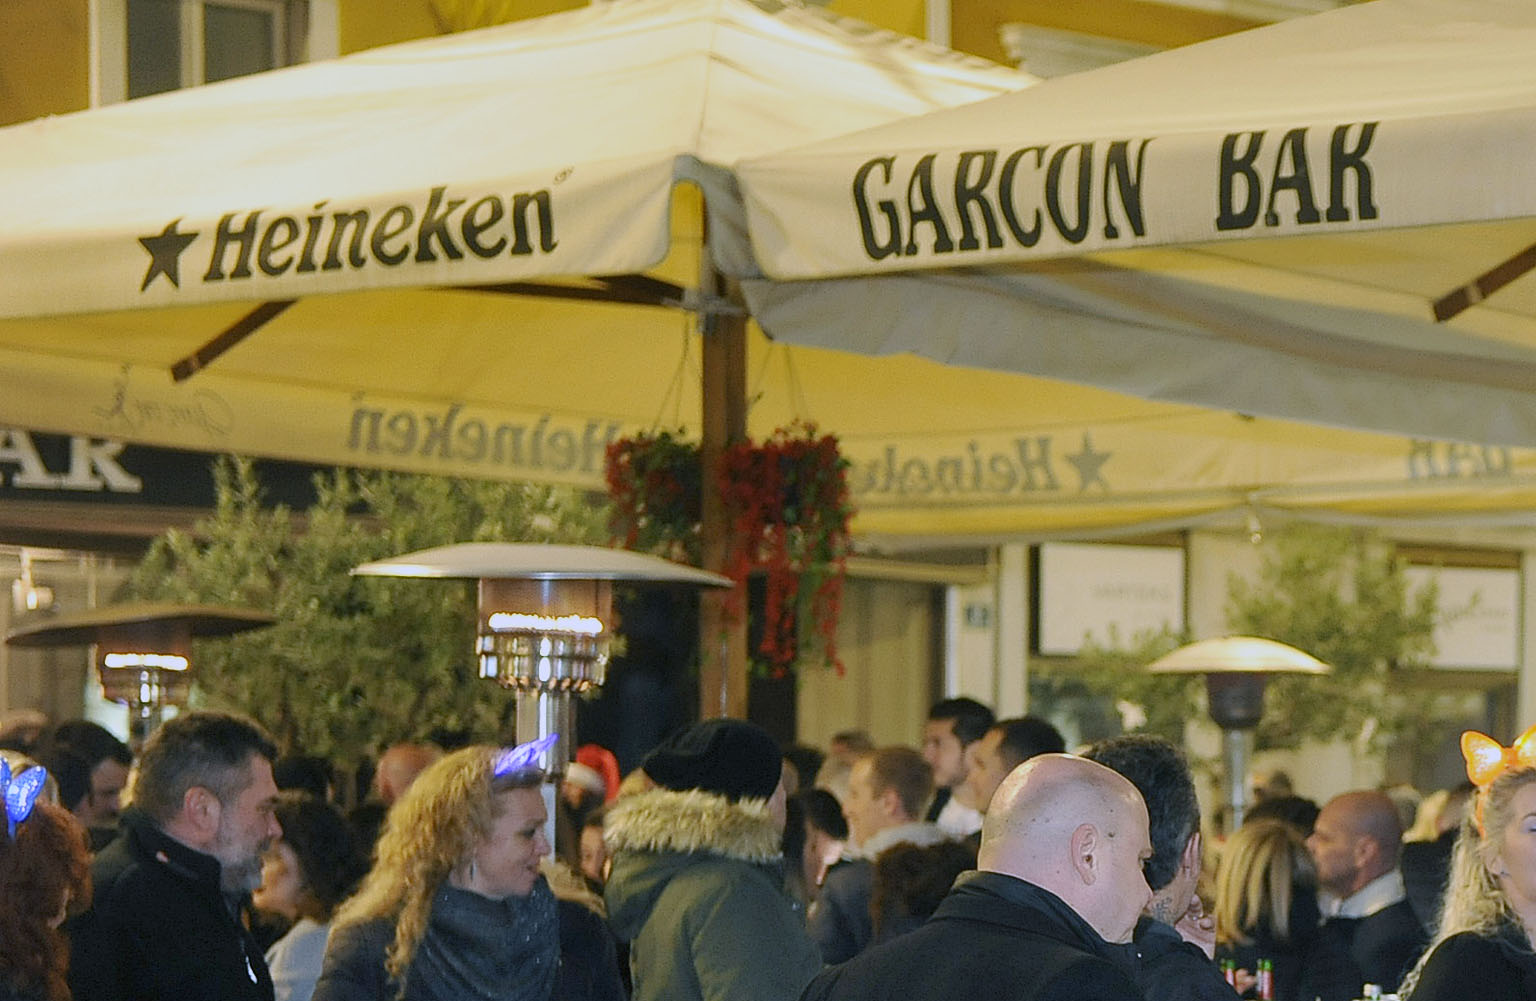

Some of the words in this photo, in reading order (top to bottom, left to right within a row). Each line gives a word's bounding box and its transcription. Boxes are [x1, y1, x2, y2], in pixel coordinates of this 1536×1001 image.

[203, 185, 558, 282] Heineken
[853, 136, 1156, 260] GARCON
[1217, 121, 1380, 231] BAR
